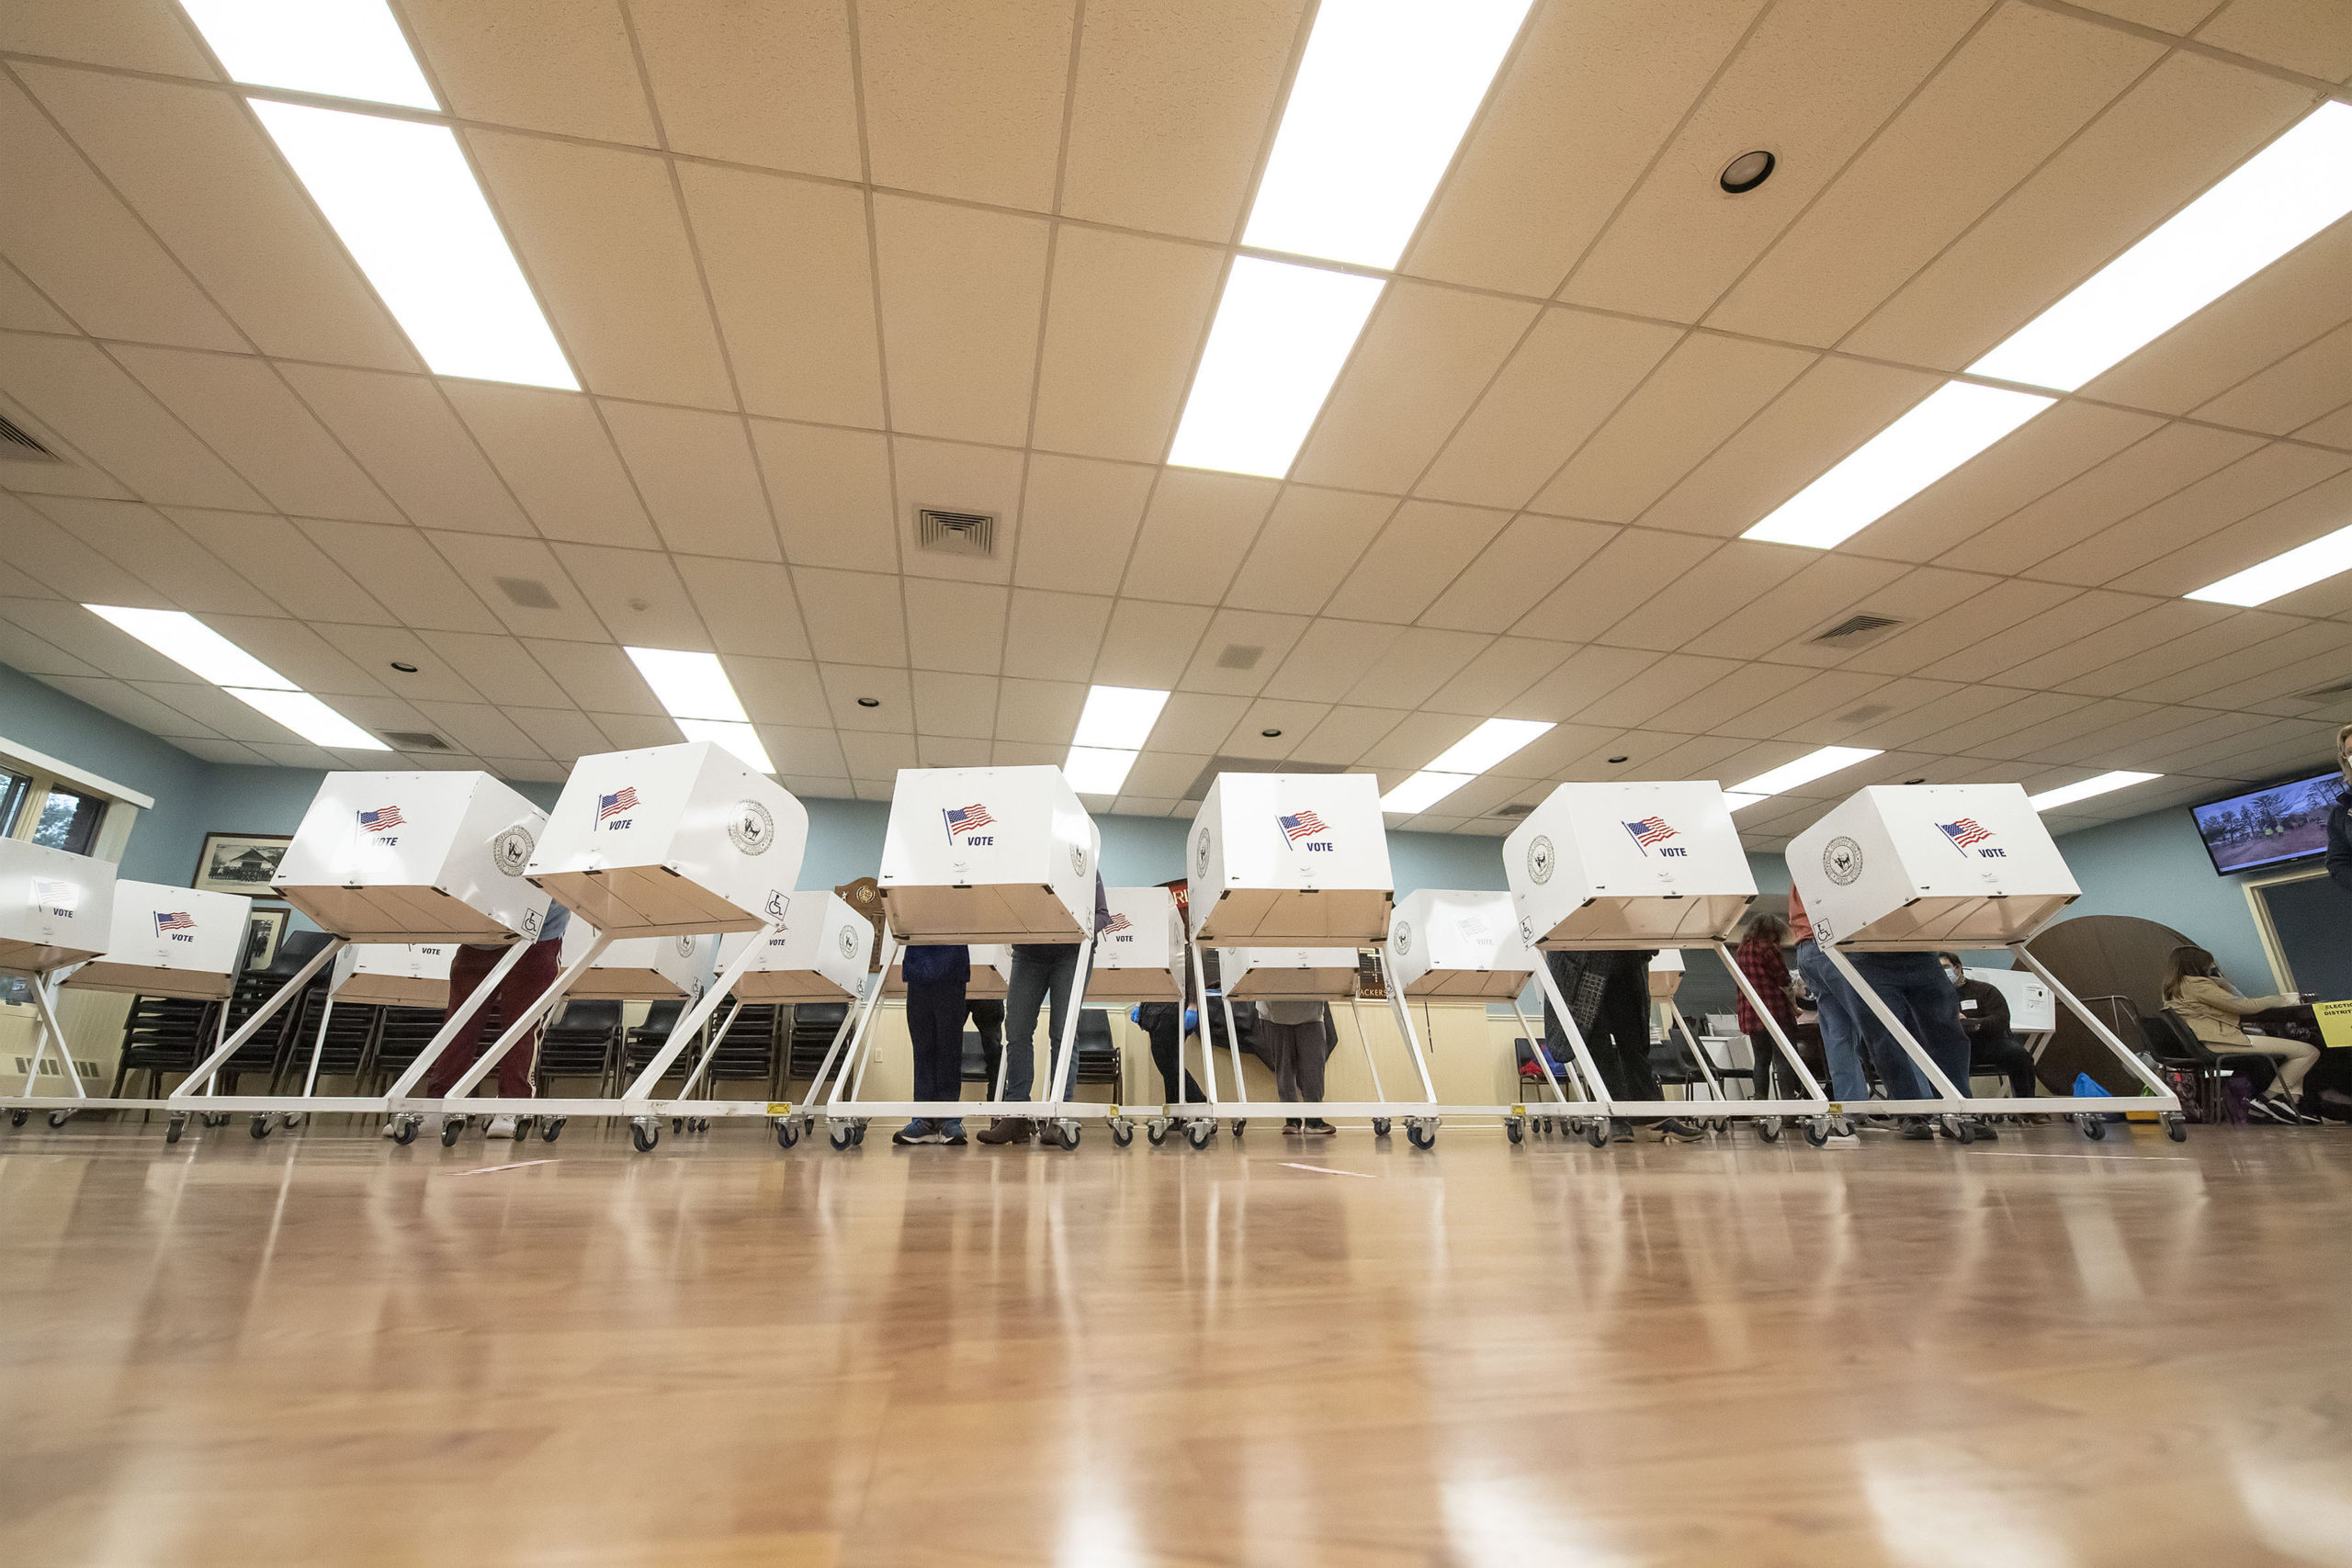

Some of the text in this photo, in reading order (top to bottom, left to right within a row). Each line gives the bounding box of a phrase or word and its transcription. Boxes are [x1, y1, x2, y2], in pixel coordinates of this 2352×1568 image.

[609, 819, 632, 830] VOTE
[967, 837, 994, 846] VOTE
[1306, 842, 1333, 852] VOTE
[1659, 848, 1688, 857] VOTE
[1978, 849, 2007, 858] VOTE
[53, 908, 74, 918] VOTE
[172, 933, 194, 942] VOTE
[422, 947, 441, 955] VOTE
